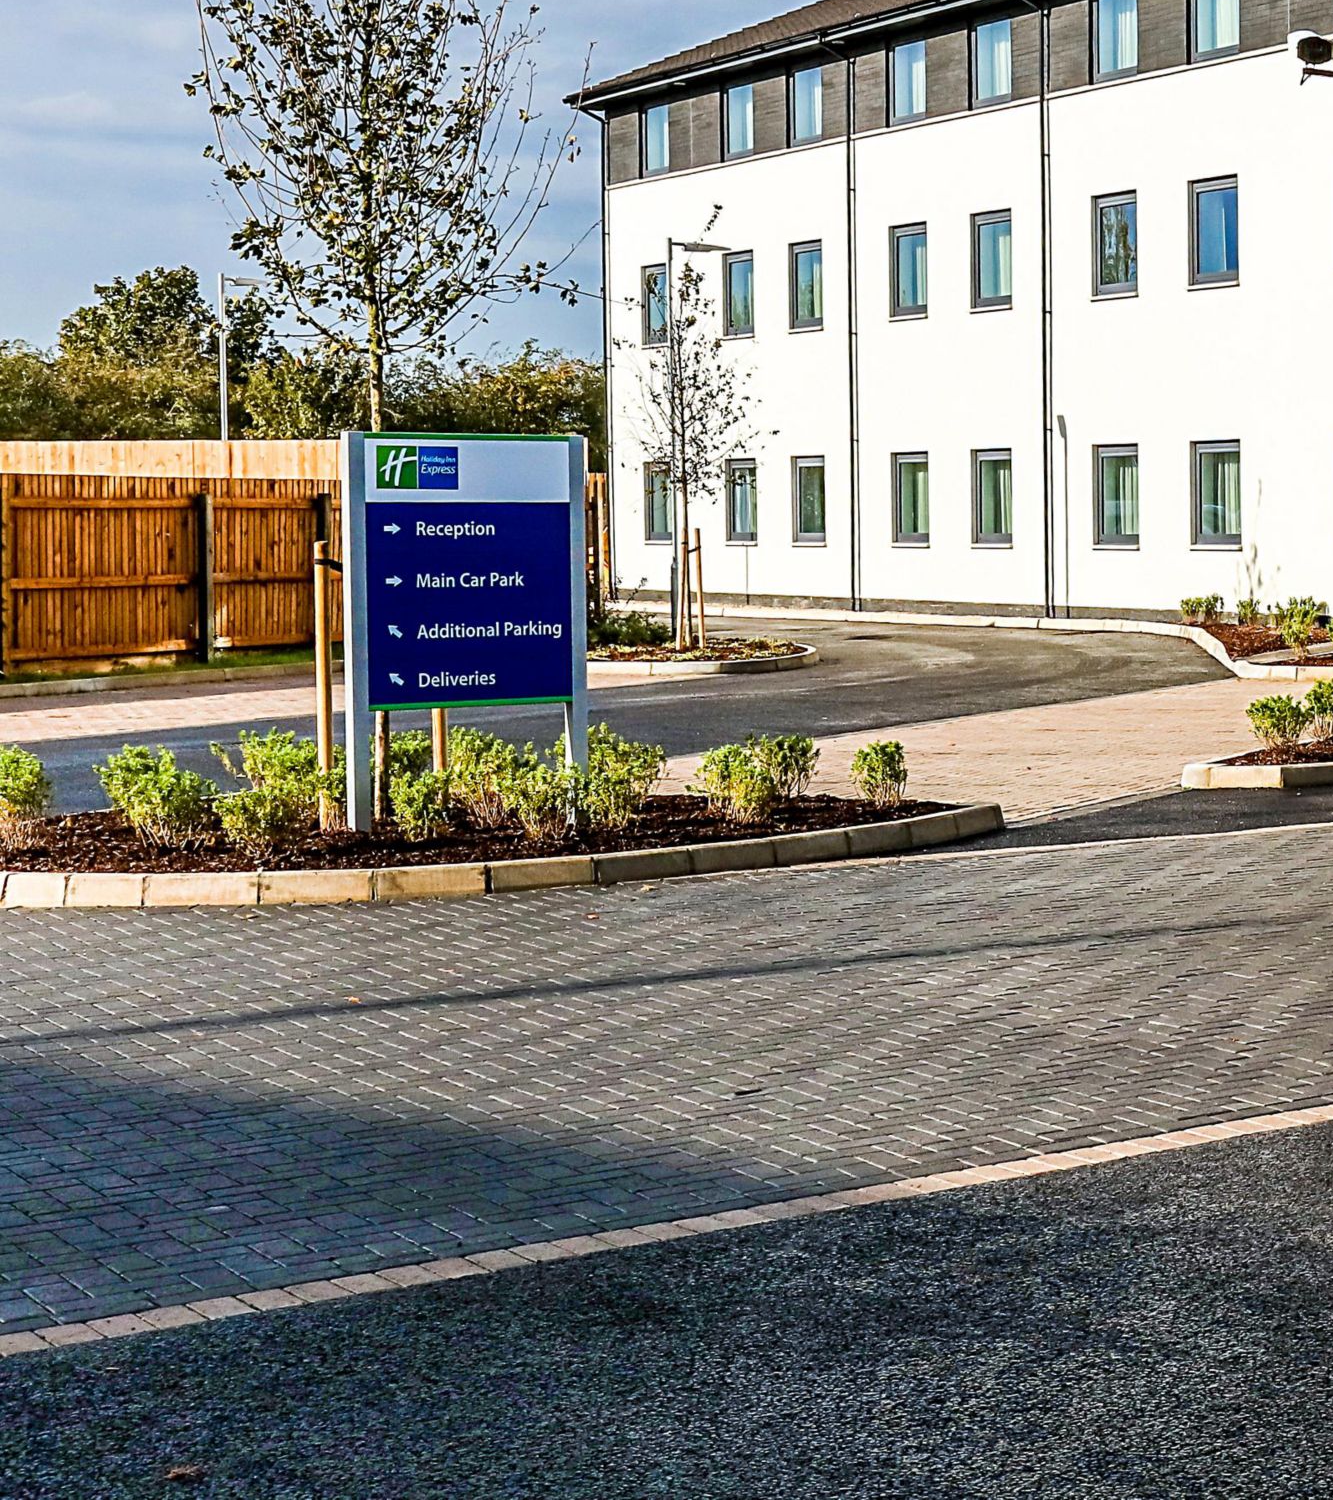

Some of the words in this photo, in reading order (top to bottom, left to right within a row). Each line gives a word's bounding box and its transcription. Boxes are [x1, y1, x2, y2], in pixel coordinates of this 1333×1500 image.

[420, 455, 445, 464] Holiday
[420, 463, 456, 476] Express
[416, 521, 496, 539] Reception
[416, 573, 455, 588] Main
[459, 572, 486, 587] Car
[490, 571, 525, 586] Park
[417, 621, 500, 639] Additional
[504, 620, 562, 639] Parking
[418, 670, 496, 688] Deliveries
